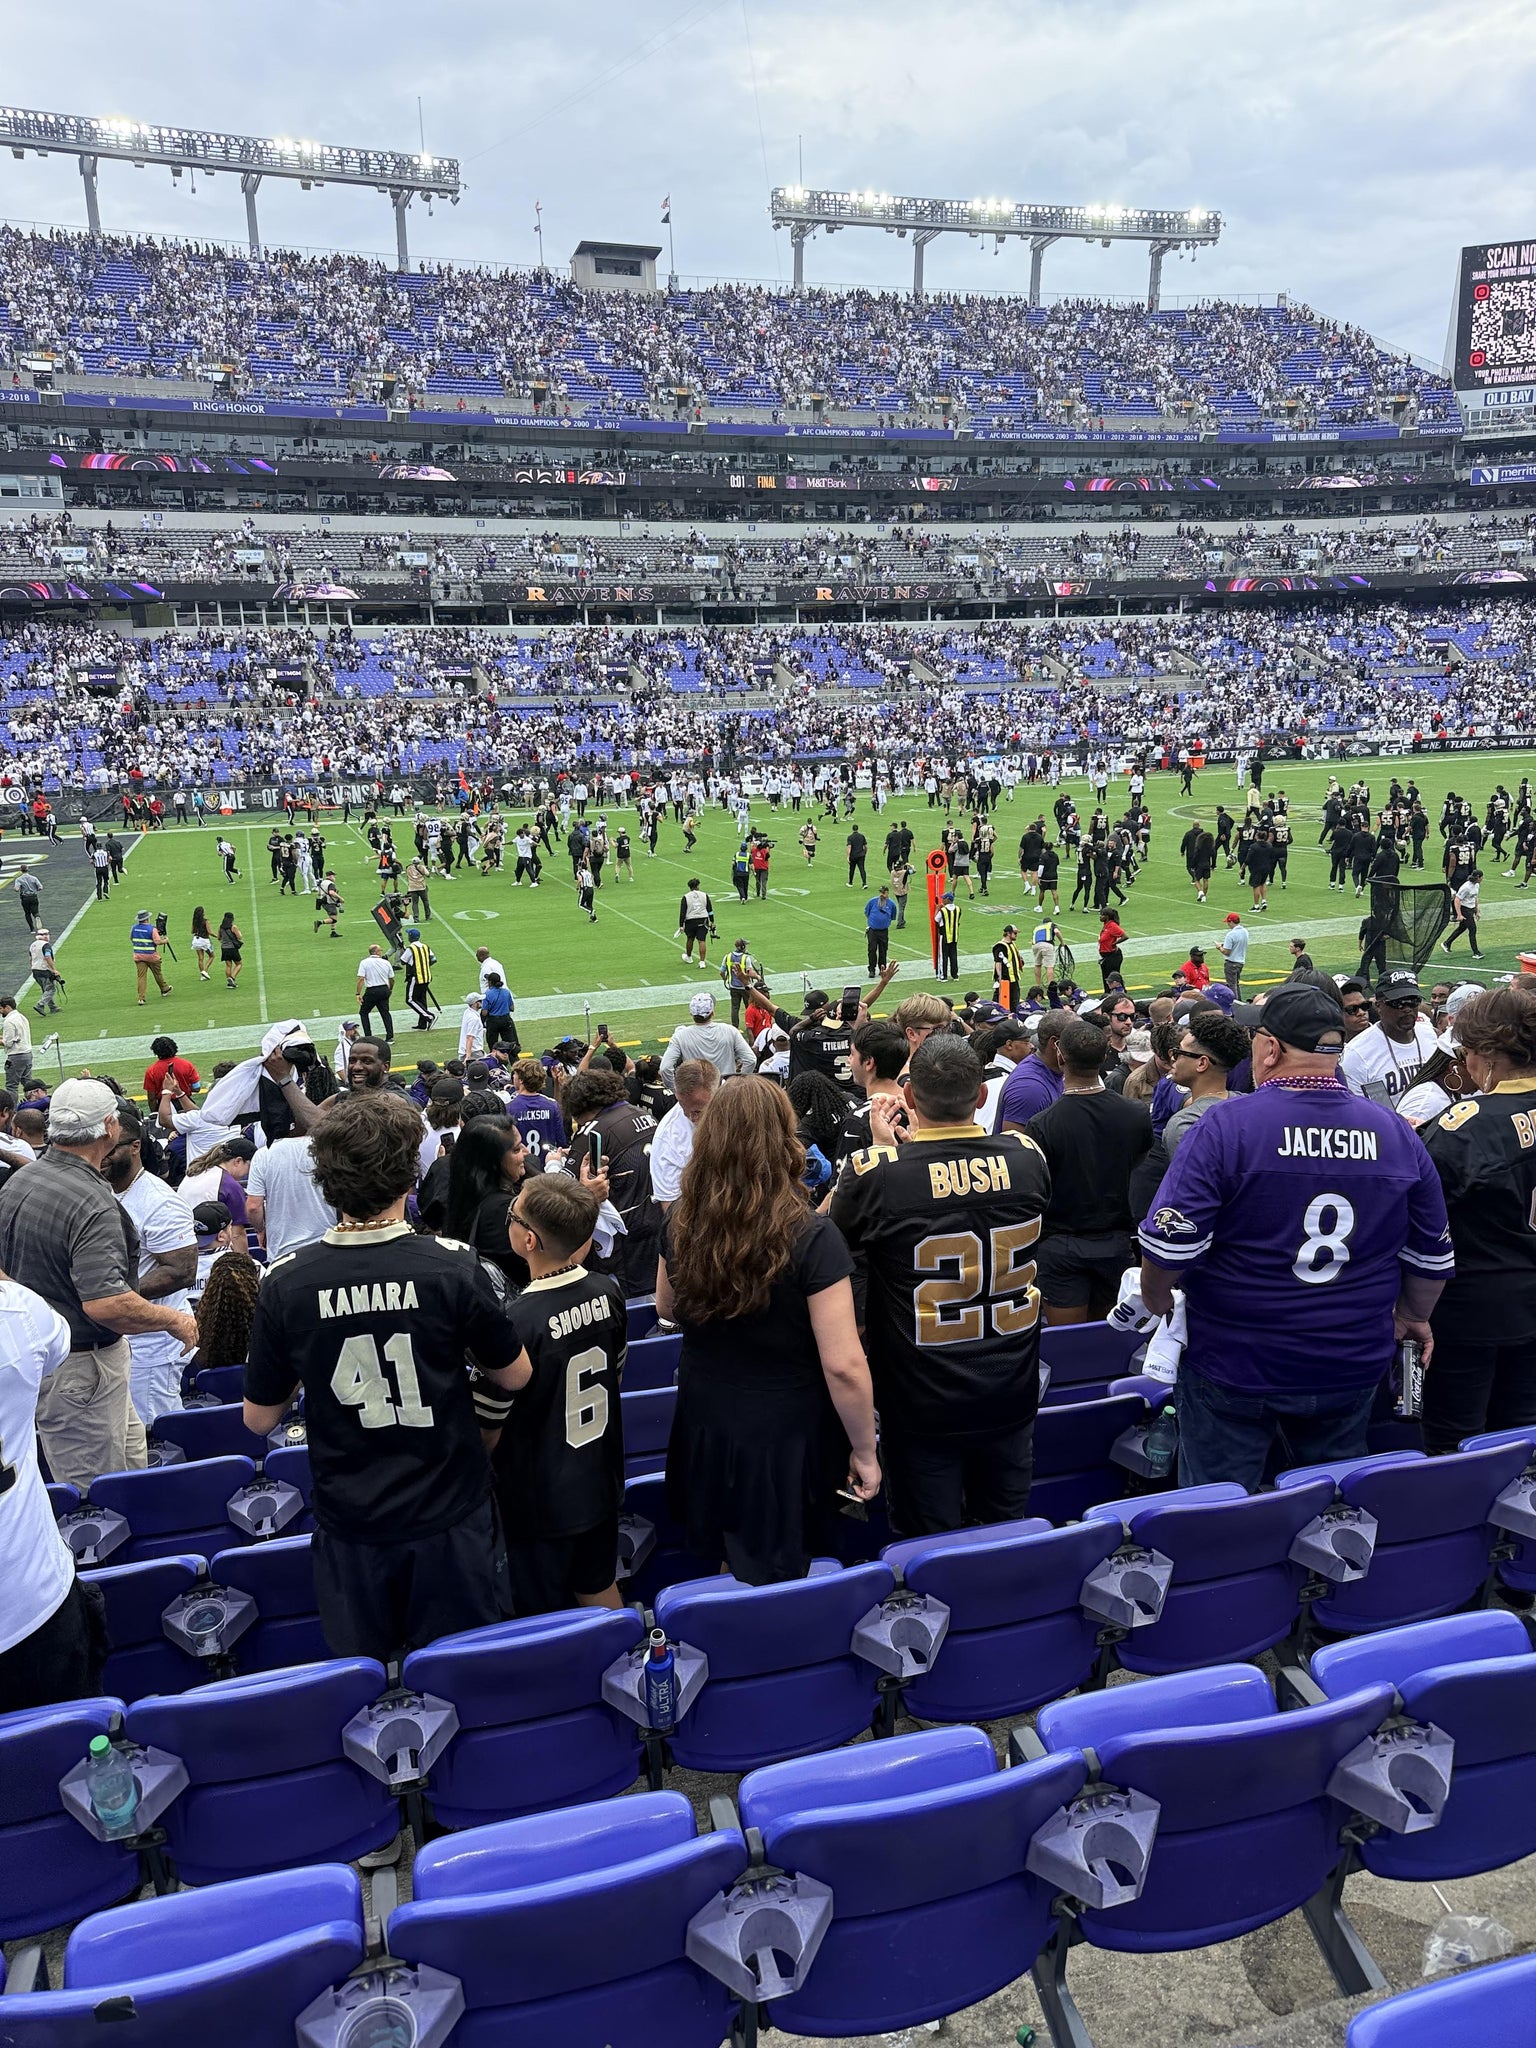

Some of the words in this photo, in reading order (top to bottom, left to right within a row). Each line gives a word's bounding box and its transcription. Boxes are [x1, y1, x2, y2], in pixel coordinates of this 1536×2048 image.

[1487, 246, 1518, 269] SCAN
[1474, 369, 1489, 379] YOUR
[1490, 367, 1510, 377] PHOTO
[1510, 366, 1523, 375] MAY
[1483, 376, 1493, 385] ON
[1486, 393, 1508, 406] OLD
[1509, 390, 1532, 404] BAY
[192, 401, 219, 412] RING
[226, 403, 266, 414] HONOR
[493, 417, 519, 426] WORLD
[520, 418, 560, 427] CHAMPIONS
[573, 420, 590, 428] 2000
[604, 421, 620, 429] 2012
[802, 428, 814, 436] AFC
[815, 428, 850, 437] CHAMPIONS
[850, 429, 866, 437] 2000
[1272, 433, 1287, 442] THANK
[1439, 427, 1463, 435] HONOR
[1501, 466, 1536, 478] merritt
[555, 470, 565, 484] 24
[619, 472, 626, 486] 17
[757, 476, 777, 489] FINAL
[806, 477, 827, 488] M&T
[827, 477, 848, 489] Bank
[525, 586, 655, 602] RAVENS
[815, 586, 930, 601] RAVENS
[1450, 739, 1479, 749] FLIGHT
[1508, 737, 1531, 747] NEXT
[1208, 750, 1227, 761] NEXT
[261, 788, 279, 809] OF
[560, 796, 569, 805] 95
[738, 801, 747, 810] 21
[427, 823, 438, 833] 98
[1381, 816, 1393, 826] 55
[1241, 827, 1254, 840] 97
[1275, 830, 1287, 842] 93
[377, 906, 391, 925] 1
[833, 1055, 853, 1080] 3
[517, 1109, 551, 1122] JACKSON
[1438, 1100, 1480, 1131] 9
[525, 1129, 541, 1157] 8
[1277, 1126, 1378, 1161] JACKSON
[928, 1155, 1011, 1199] BUSH
[1291, 1192, 1355, 1284] 8
[914, 1213, 1042, 1346] 25
[317, 1280, 420, 1320] KAMARA
[547, 1294, 612, 1341] SHOUGH
[1161, 1366, 1175, 1375] Bank
[330, 1332, 435, 1429] 41
[565, 1345, 609, 1450] 6
[659, 1679, 671, 1714] ULTRA
